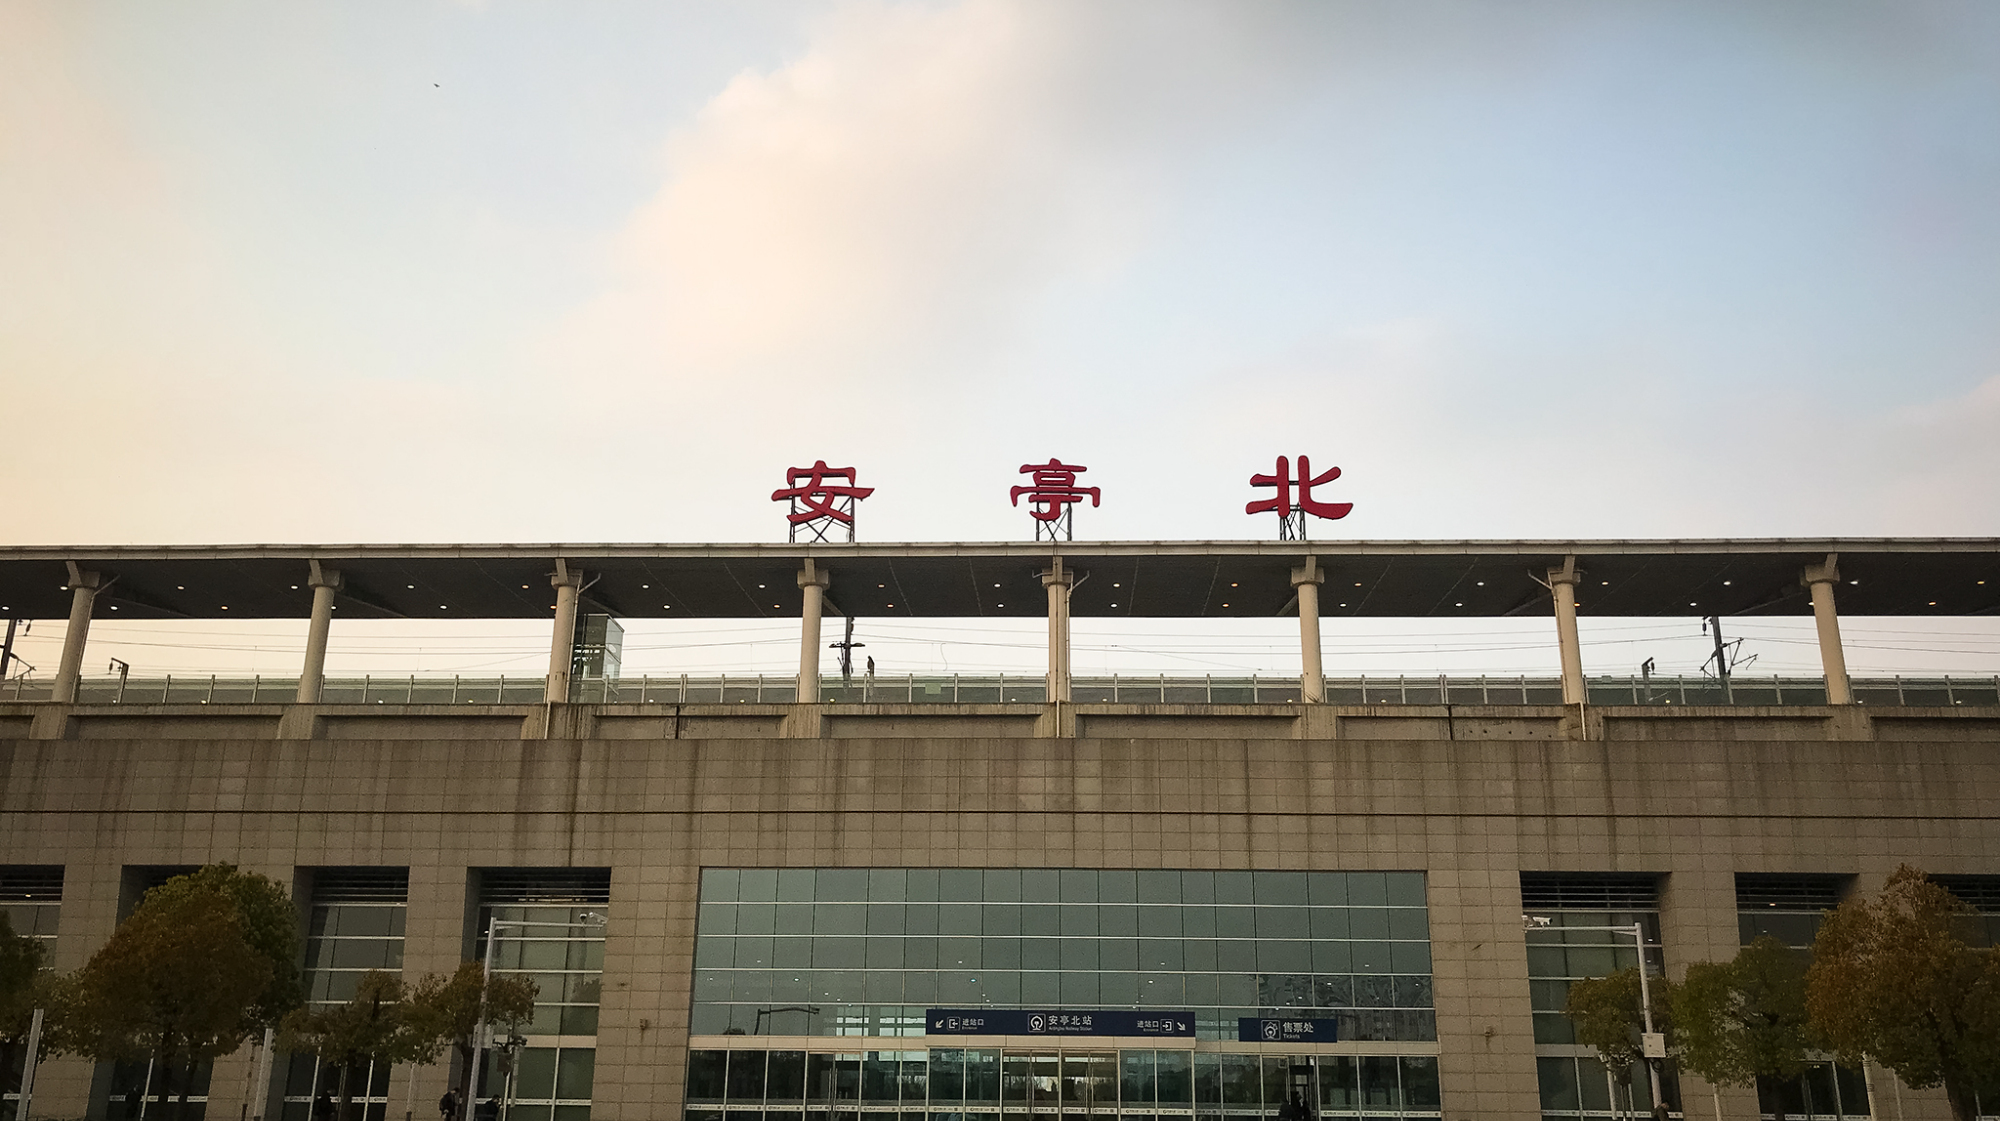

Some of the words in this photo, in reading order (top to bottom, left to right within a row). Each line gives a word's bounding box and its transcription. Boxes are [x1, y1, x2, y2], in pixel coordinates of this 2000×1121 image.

[771, 455, 1353, 523] 安亭北
[962, 1018, 984, 1026] 进站口
[1048, 1015, 1092, 1026] 安亭北站
[1137, 1020, 1159, 1028] 进站口
[1283, 1022, 1314, 1033] 售票处
